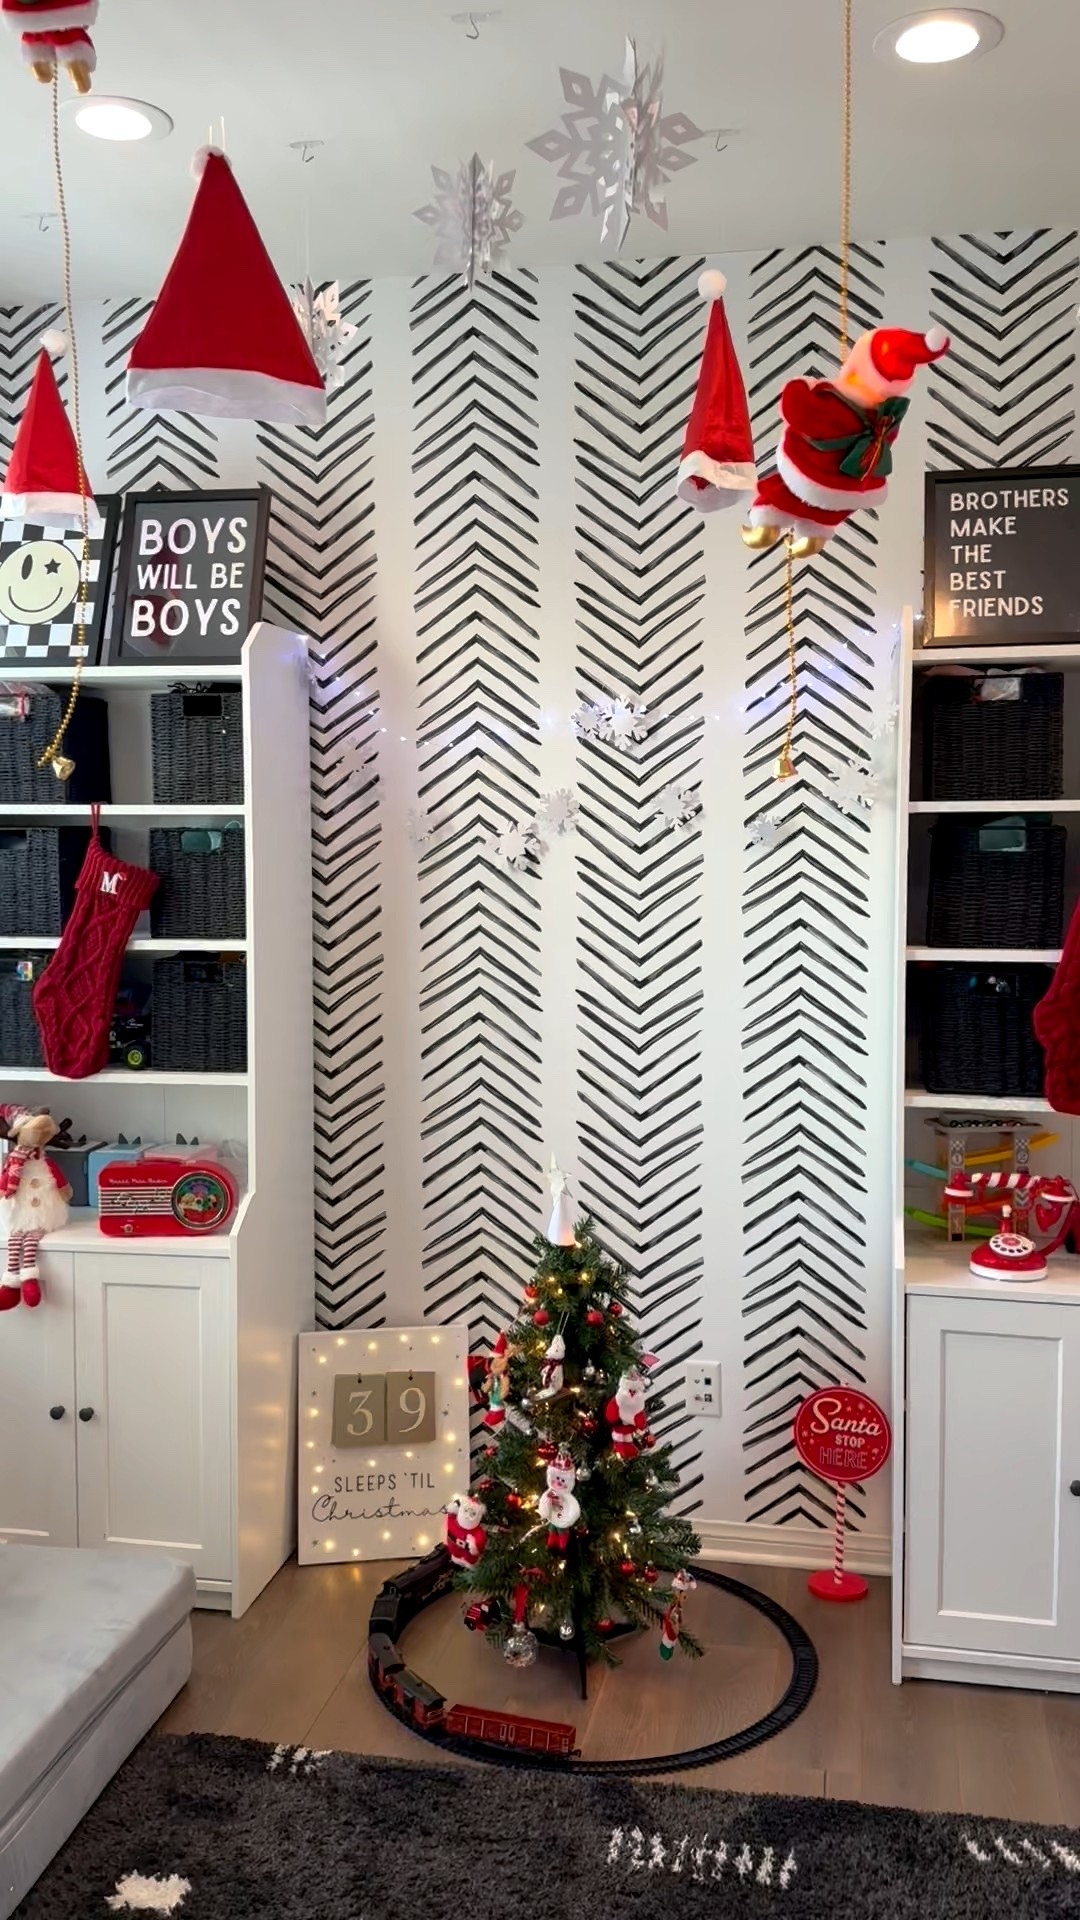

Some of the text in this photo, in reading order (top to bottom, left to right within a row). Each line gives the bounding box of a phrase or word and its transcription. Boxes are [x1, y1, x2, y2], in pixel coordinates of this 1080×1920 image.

[951, 488, 1069, 511] BROTHERS
[139, 517, 248, 555] BOYS
[951, 516, 1017, 537] MAKE
[951, 544, 992, 564] THE
[137, 562, 245, 590] WILL BE
[950, 570, 1006, 591] BEST
[131, 598, 241, 637] BOYS
[950, 596, 1044, 618] FRIENDS
[100, 871, 119, 895] M
[810, 1397, 882, 1436] Santa
[835, 1434, 865, 1448] STOP
[820, 1446, 868, 1469] HERE
[334, 1474, 397, 1493] SLEEPS
[312, 1494, 449, 1522] Christmas
